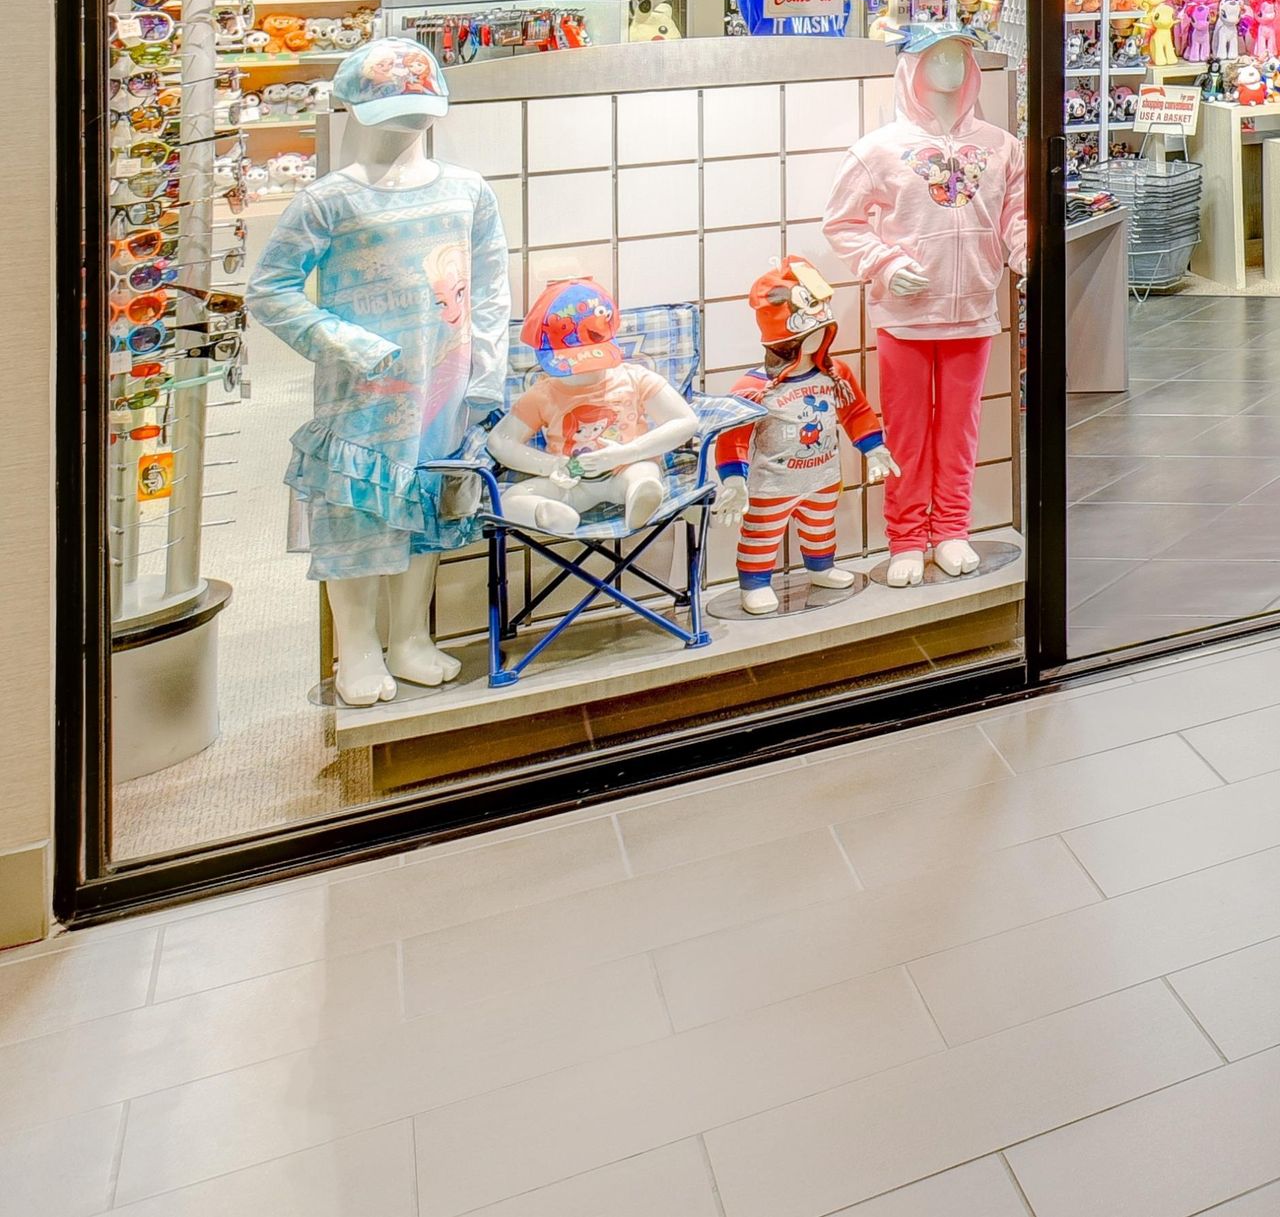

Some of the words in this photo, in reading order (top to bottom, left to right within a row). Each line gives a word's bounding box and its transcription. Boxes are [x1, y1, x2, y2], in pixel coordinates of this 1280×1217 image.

[772, 17, 786, 34] IT
[1139, 111, 1155, 121] USE
[1156, 113, 1162, 121] A
[1163, 113, 1192, 123] BASKET
[776, 385, 832, 408] AMERICAN
[787, 451, 835, 470] ORIGINAL
